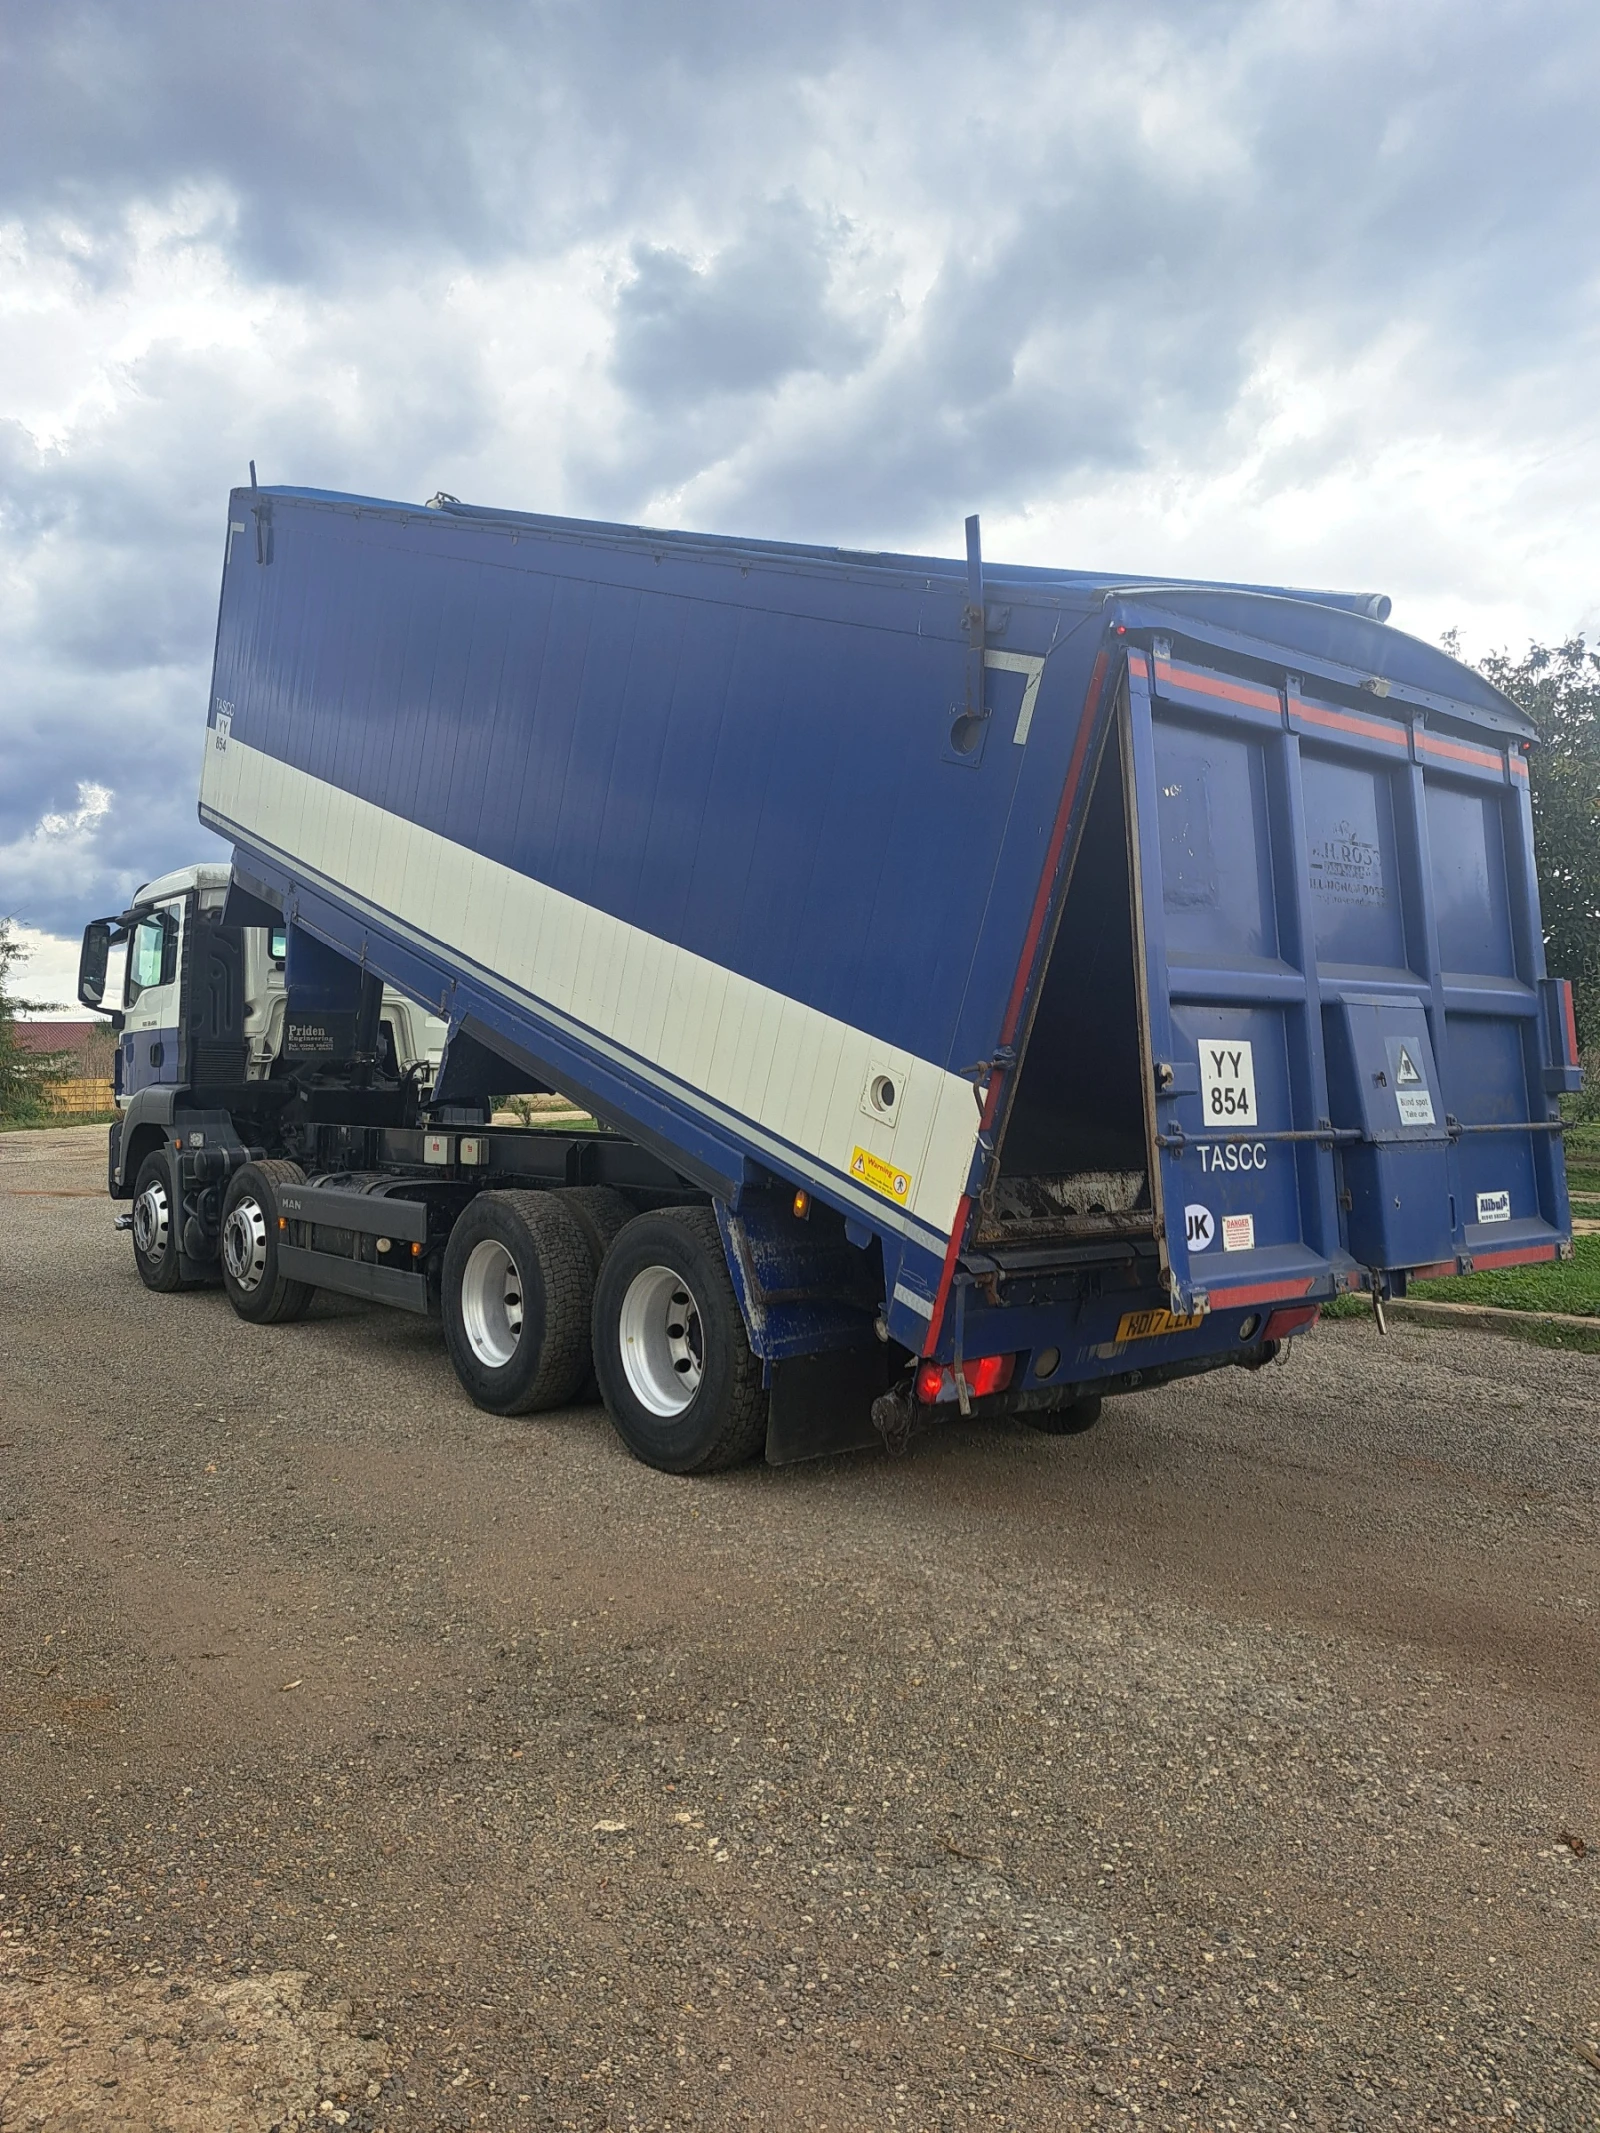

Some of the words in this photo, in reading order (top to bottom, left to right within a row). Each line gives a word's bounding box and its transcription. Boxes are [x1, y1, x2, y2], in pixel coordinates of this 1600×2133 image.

[216, 697, 234, 716] TASCC
[219, 718, 228, 734] YY
[216, 736, 226, 752] 854
[288, 1024, 326, 1036] Priden
[288, 1035, 334, 1043] Engineering
[1210, 1050, 1242, 1078] YY
[1211, 1087, 1249, 1115] 854
[1416, 1098, 1429, 1108] spot
[1196, 1143, 1267, 1172] TASCC
[867, 1156, 893, 1179] Warning
[282, 1198, 301, 1210] MAN
[1480, 1194, 1508, 1212] Alibulk
[1226, 1218, 1250, 1229] DANGER
